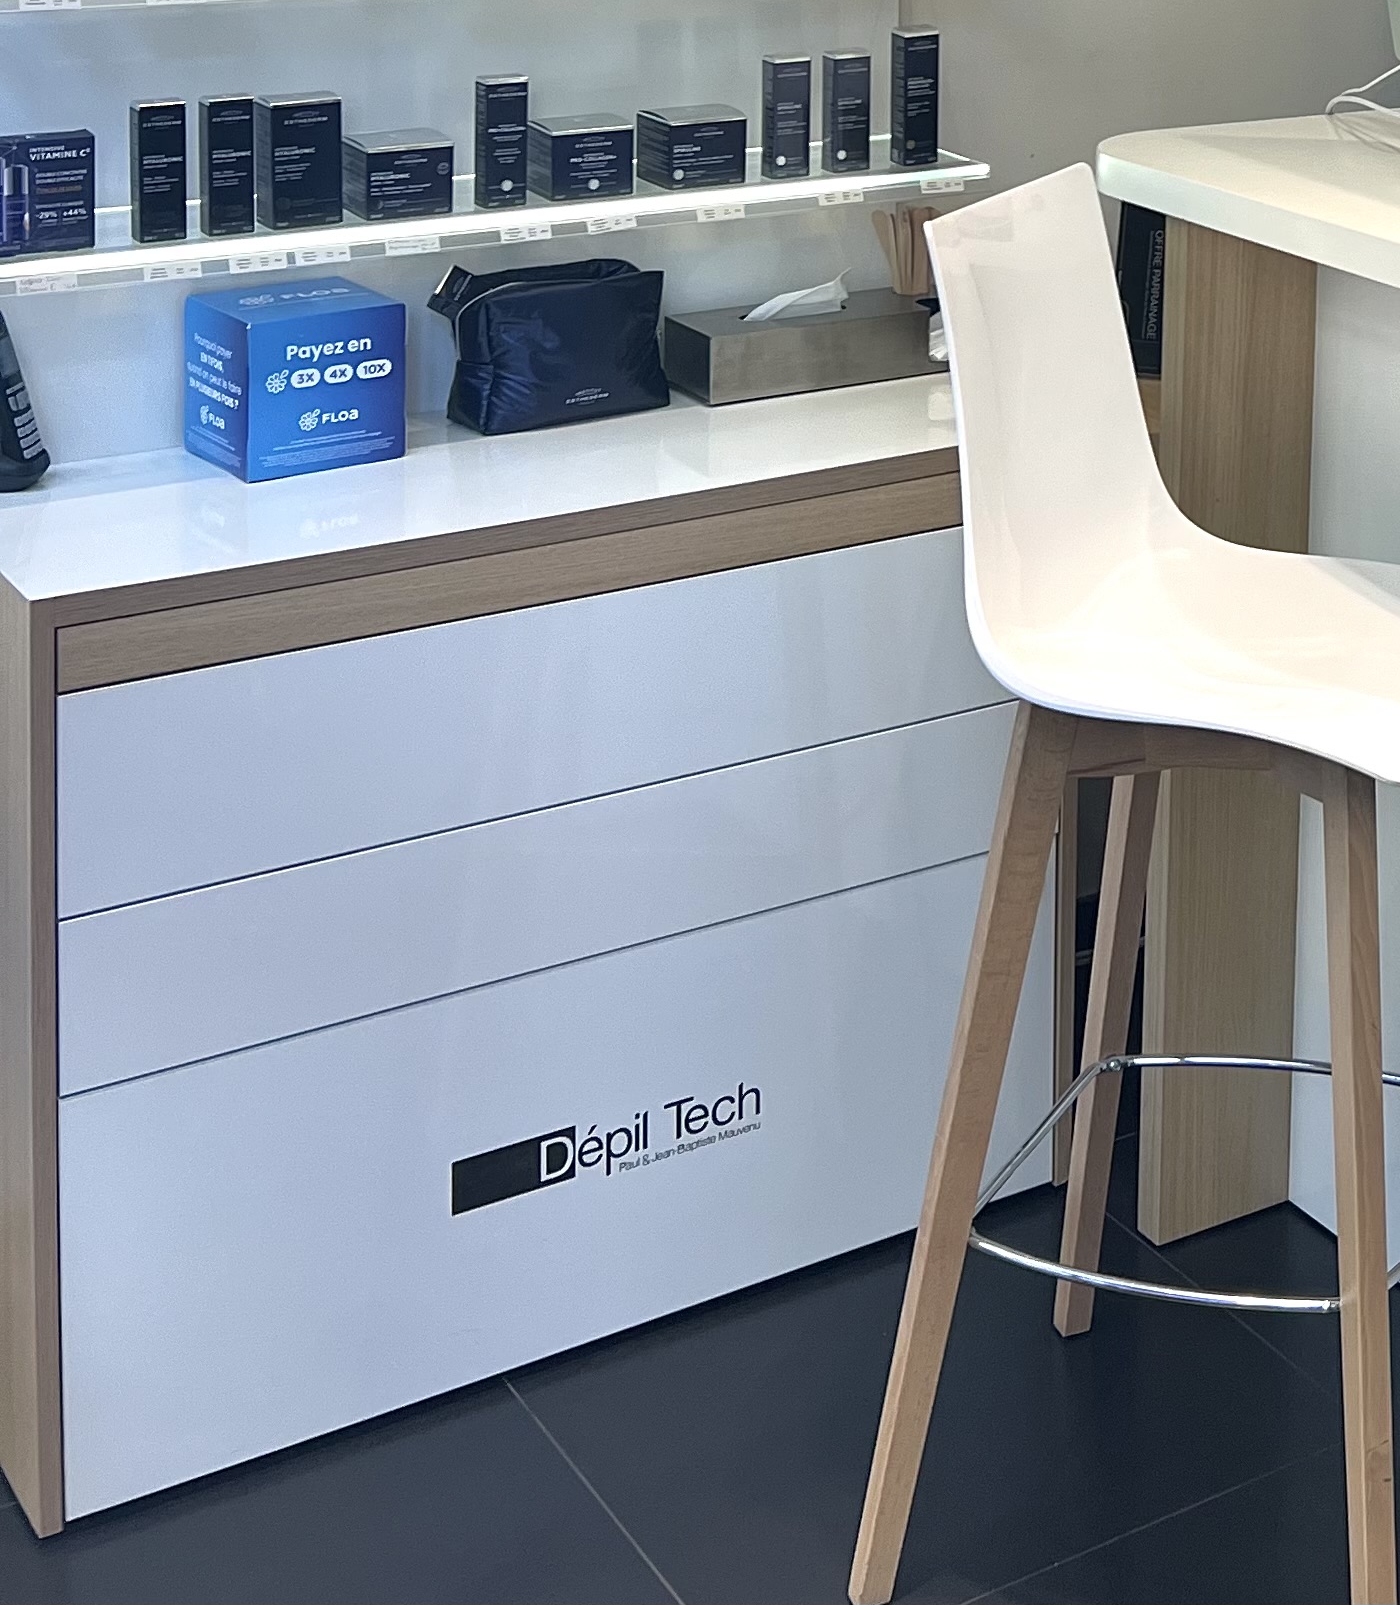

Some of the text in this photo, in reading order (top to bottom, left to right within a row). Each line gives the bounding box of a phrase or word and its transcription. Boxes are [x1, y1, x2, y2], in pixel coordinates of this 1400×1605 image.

[29, 150, 77, 161] VITAMINE
[1152, 229, 1164, 266] OFFRE
[1146, 268, 1162, 340] PARRAINAGE
[285, 337, 372, 362] Payez en
[296, 362, 387, 385] 3X 4X 10X
[540, 1082, 761, 1183] Dépil Tech
[618, 1121, 762, 1173] Paul & Jean-Baptiste Mauvenu
